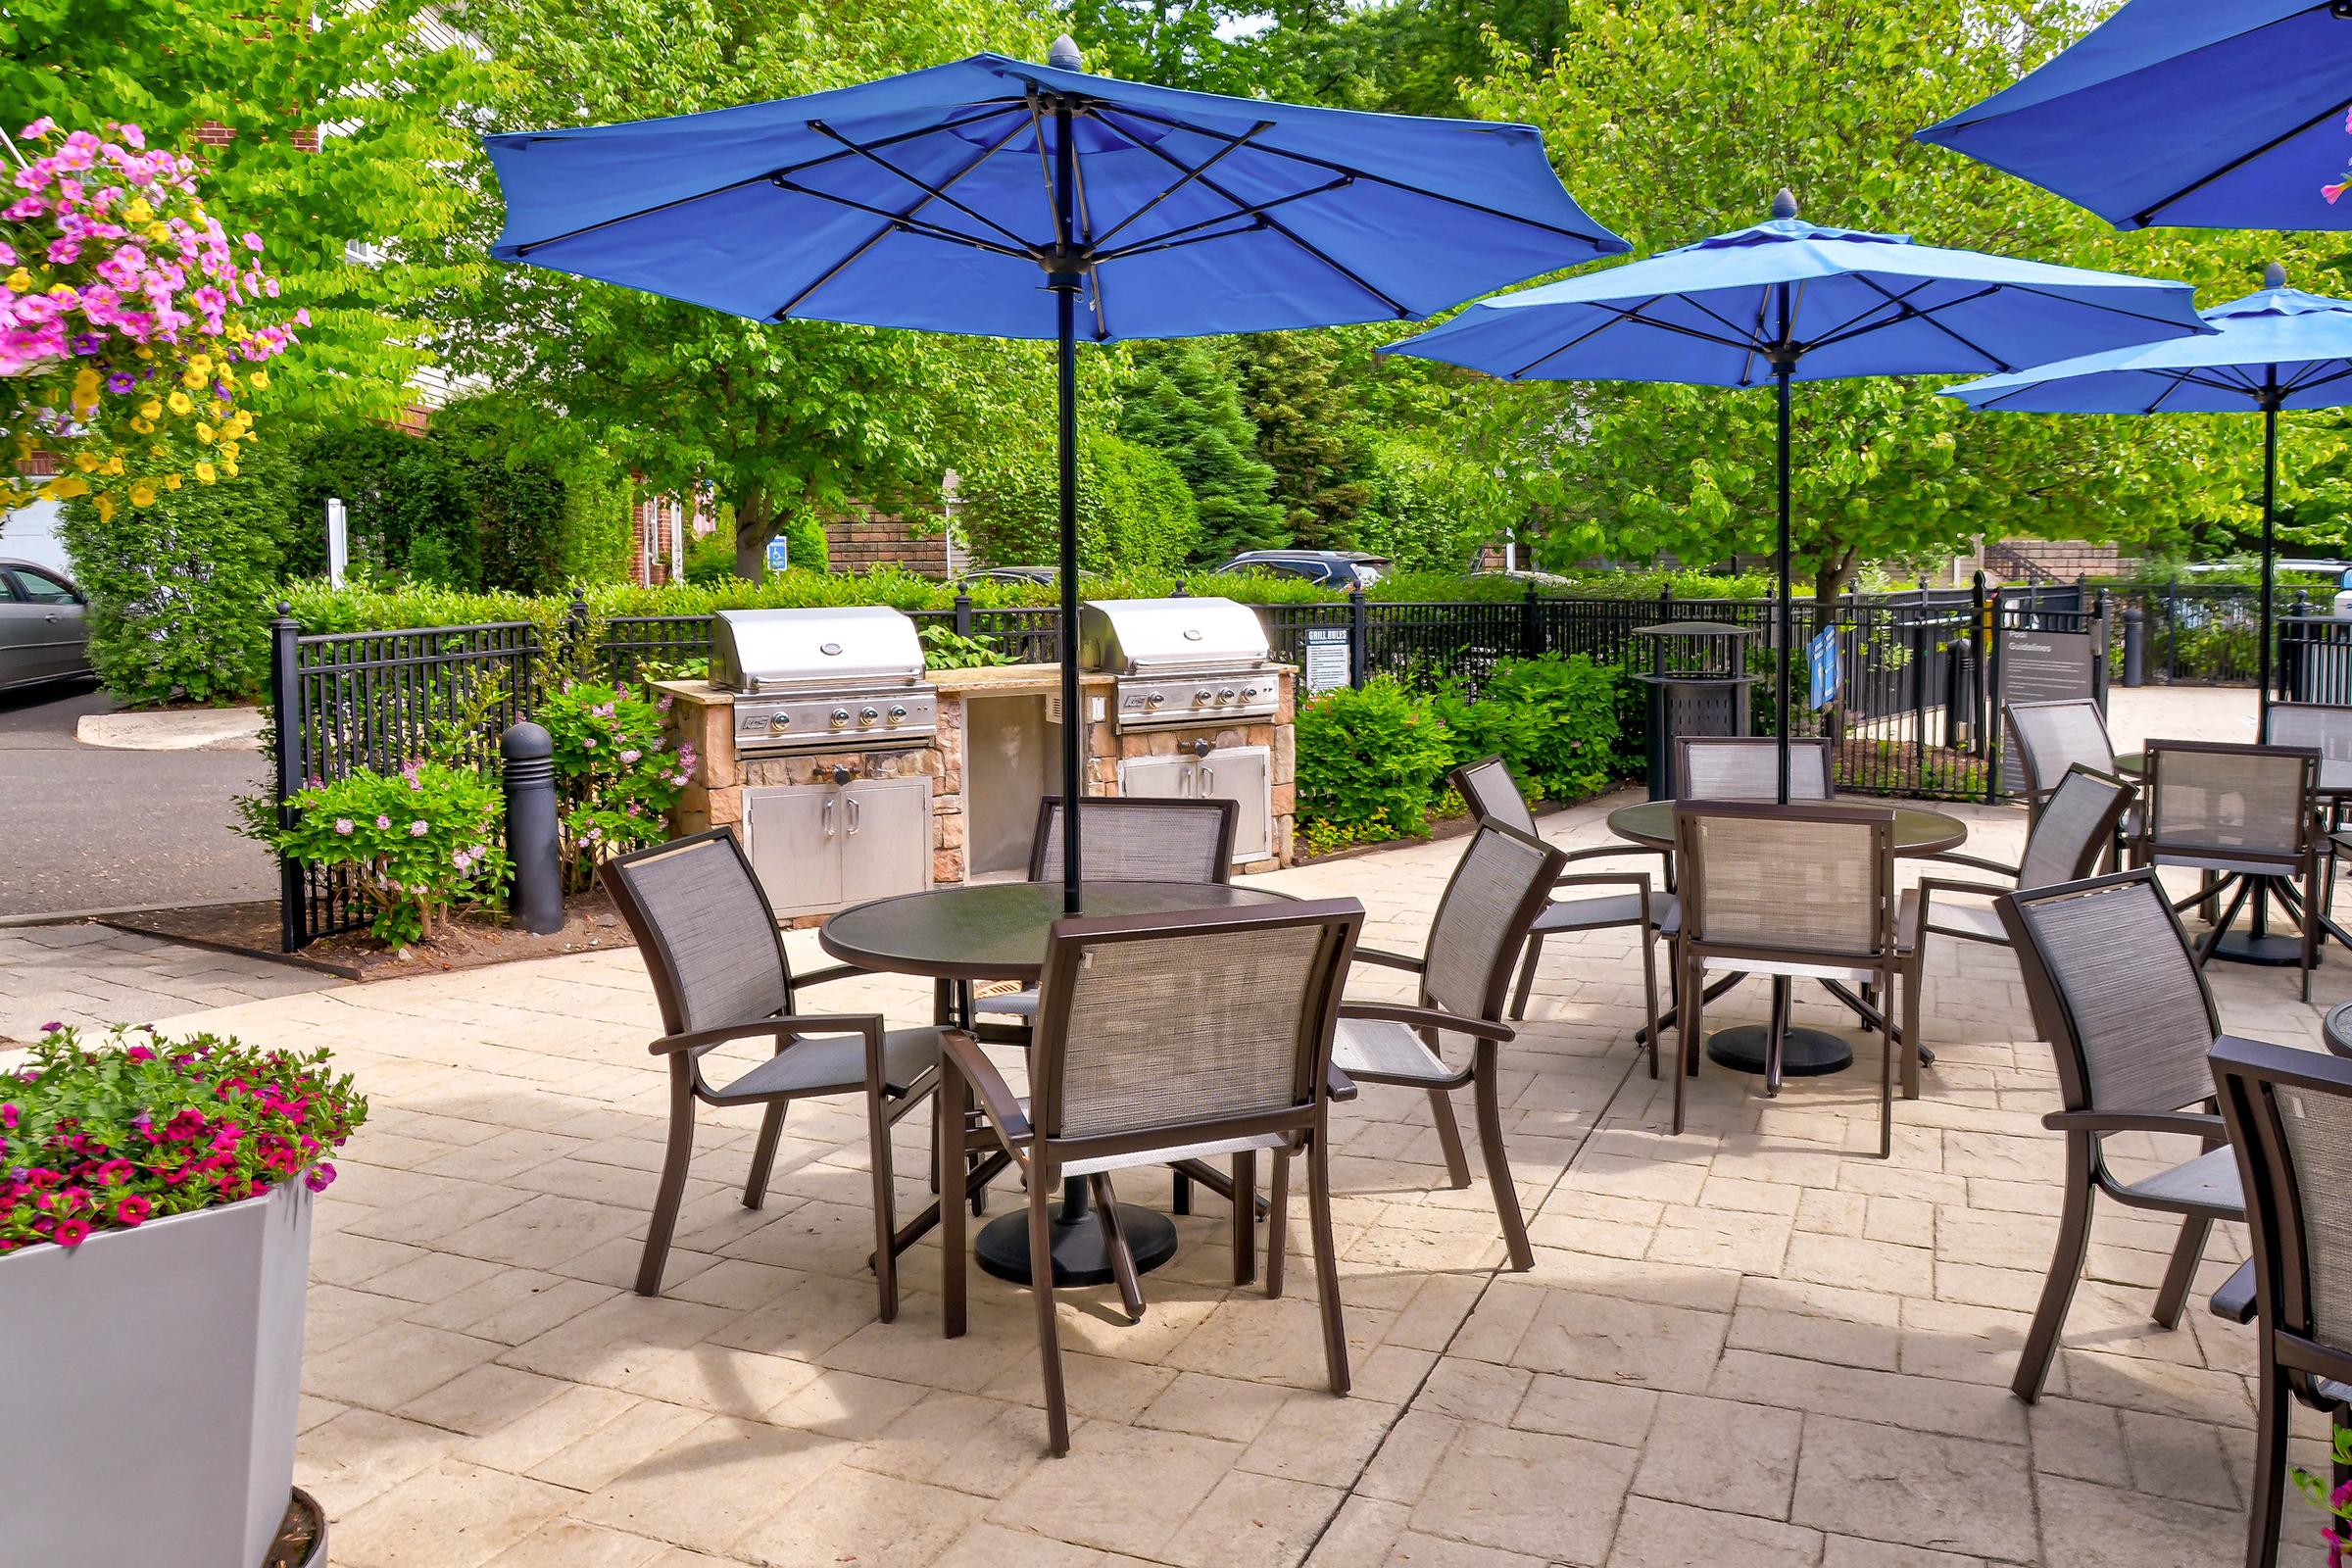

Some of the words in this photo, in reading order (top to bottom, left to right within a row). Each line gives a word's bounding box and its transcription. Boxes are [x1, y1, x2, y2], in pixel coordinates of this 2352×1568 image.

[1308, 631, 1326, 640] GRILL
[1327, 630, 1347, 640] RULES
[2008, 630, 2028, 639] Pool
[2008, 642, 2052, 653] Guidelines
